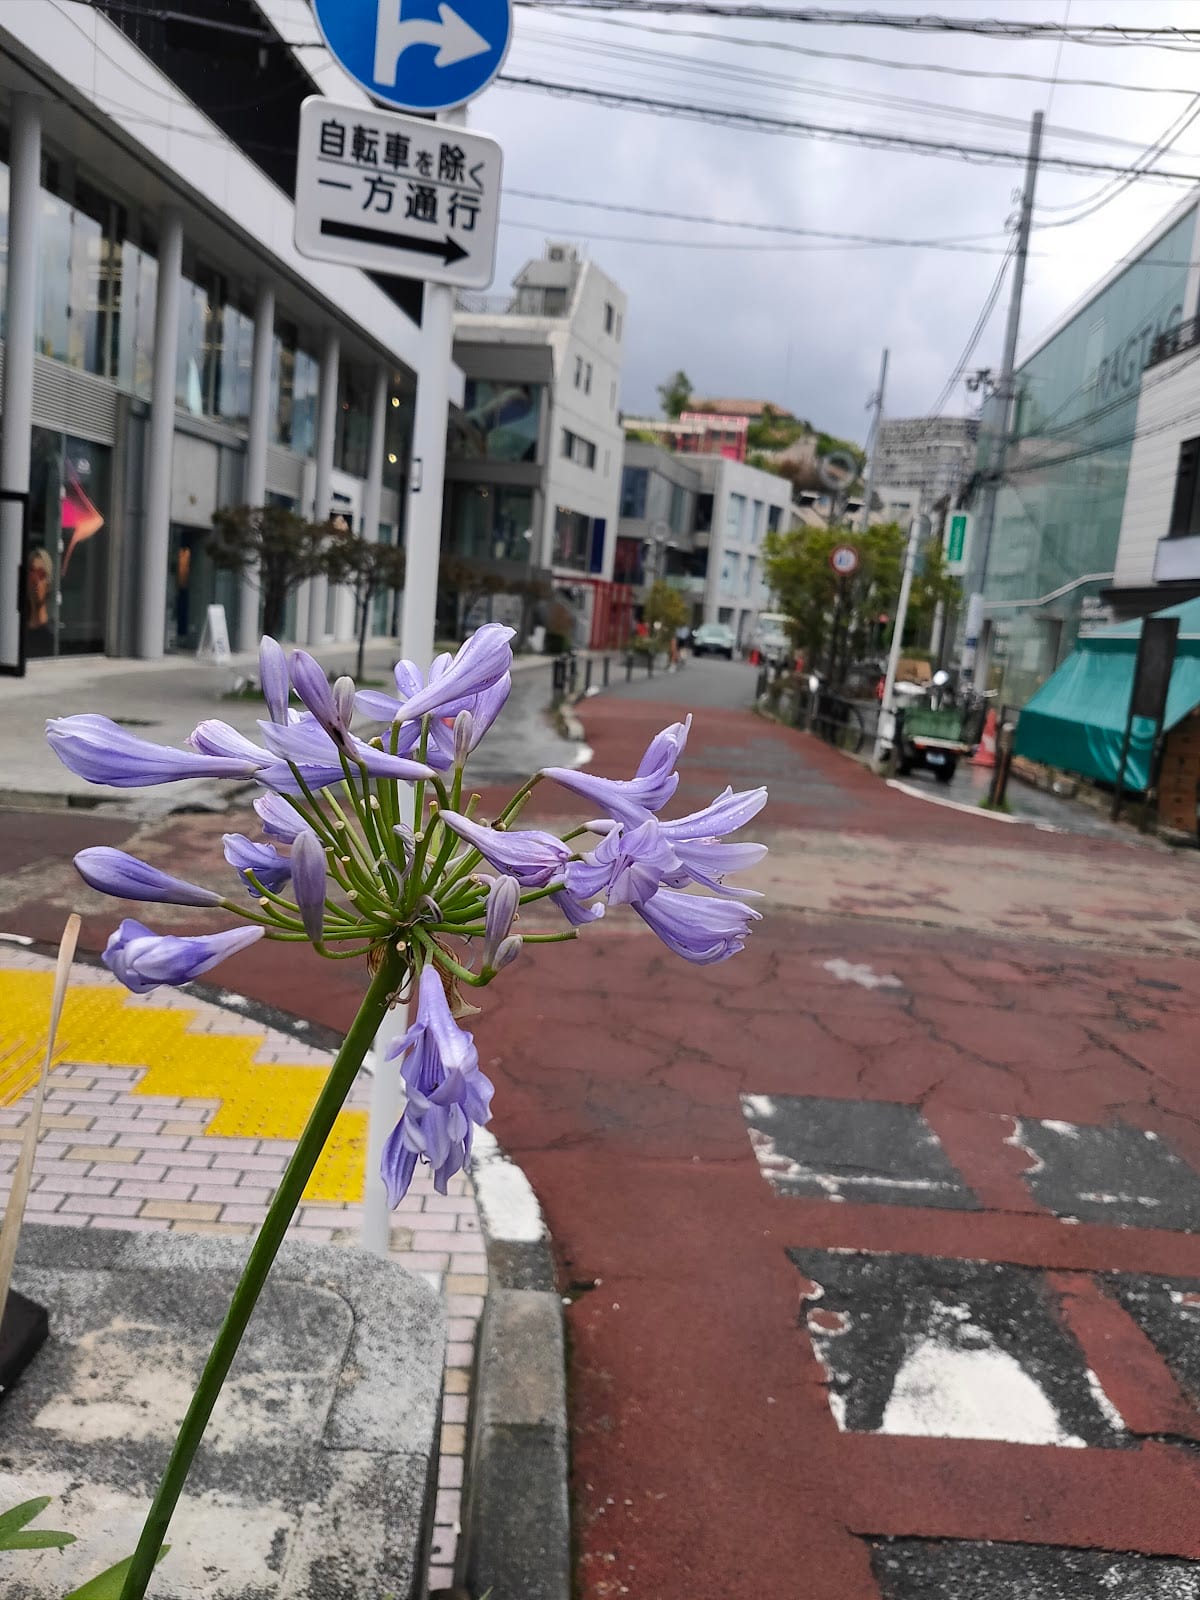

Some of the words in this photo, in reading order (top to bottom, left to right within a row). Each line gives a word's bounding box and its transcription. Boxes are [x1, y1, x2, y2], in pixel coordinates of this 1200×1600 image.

[320, 120, 484, 188] 自転車を除く
[318, 175, 481, 231] 一方通行
